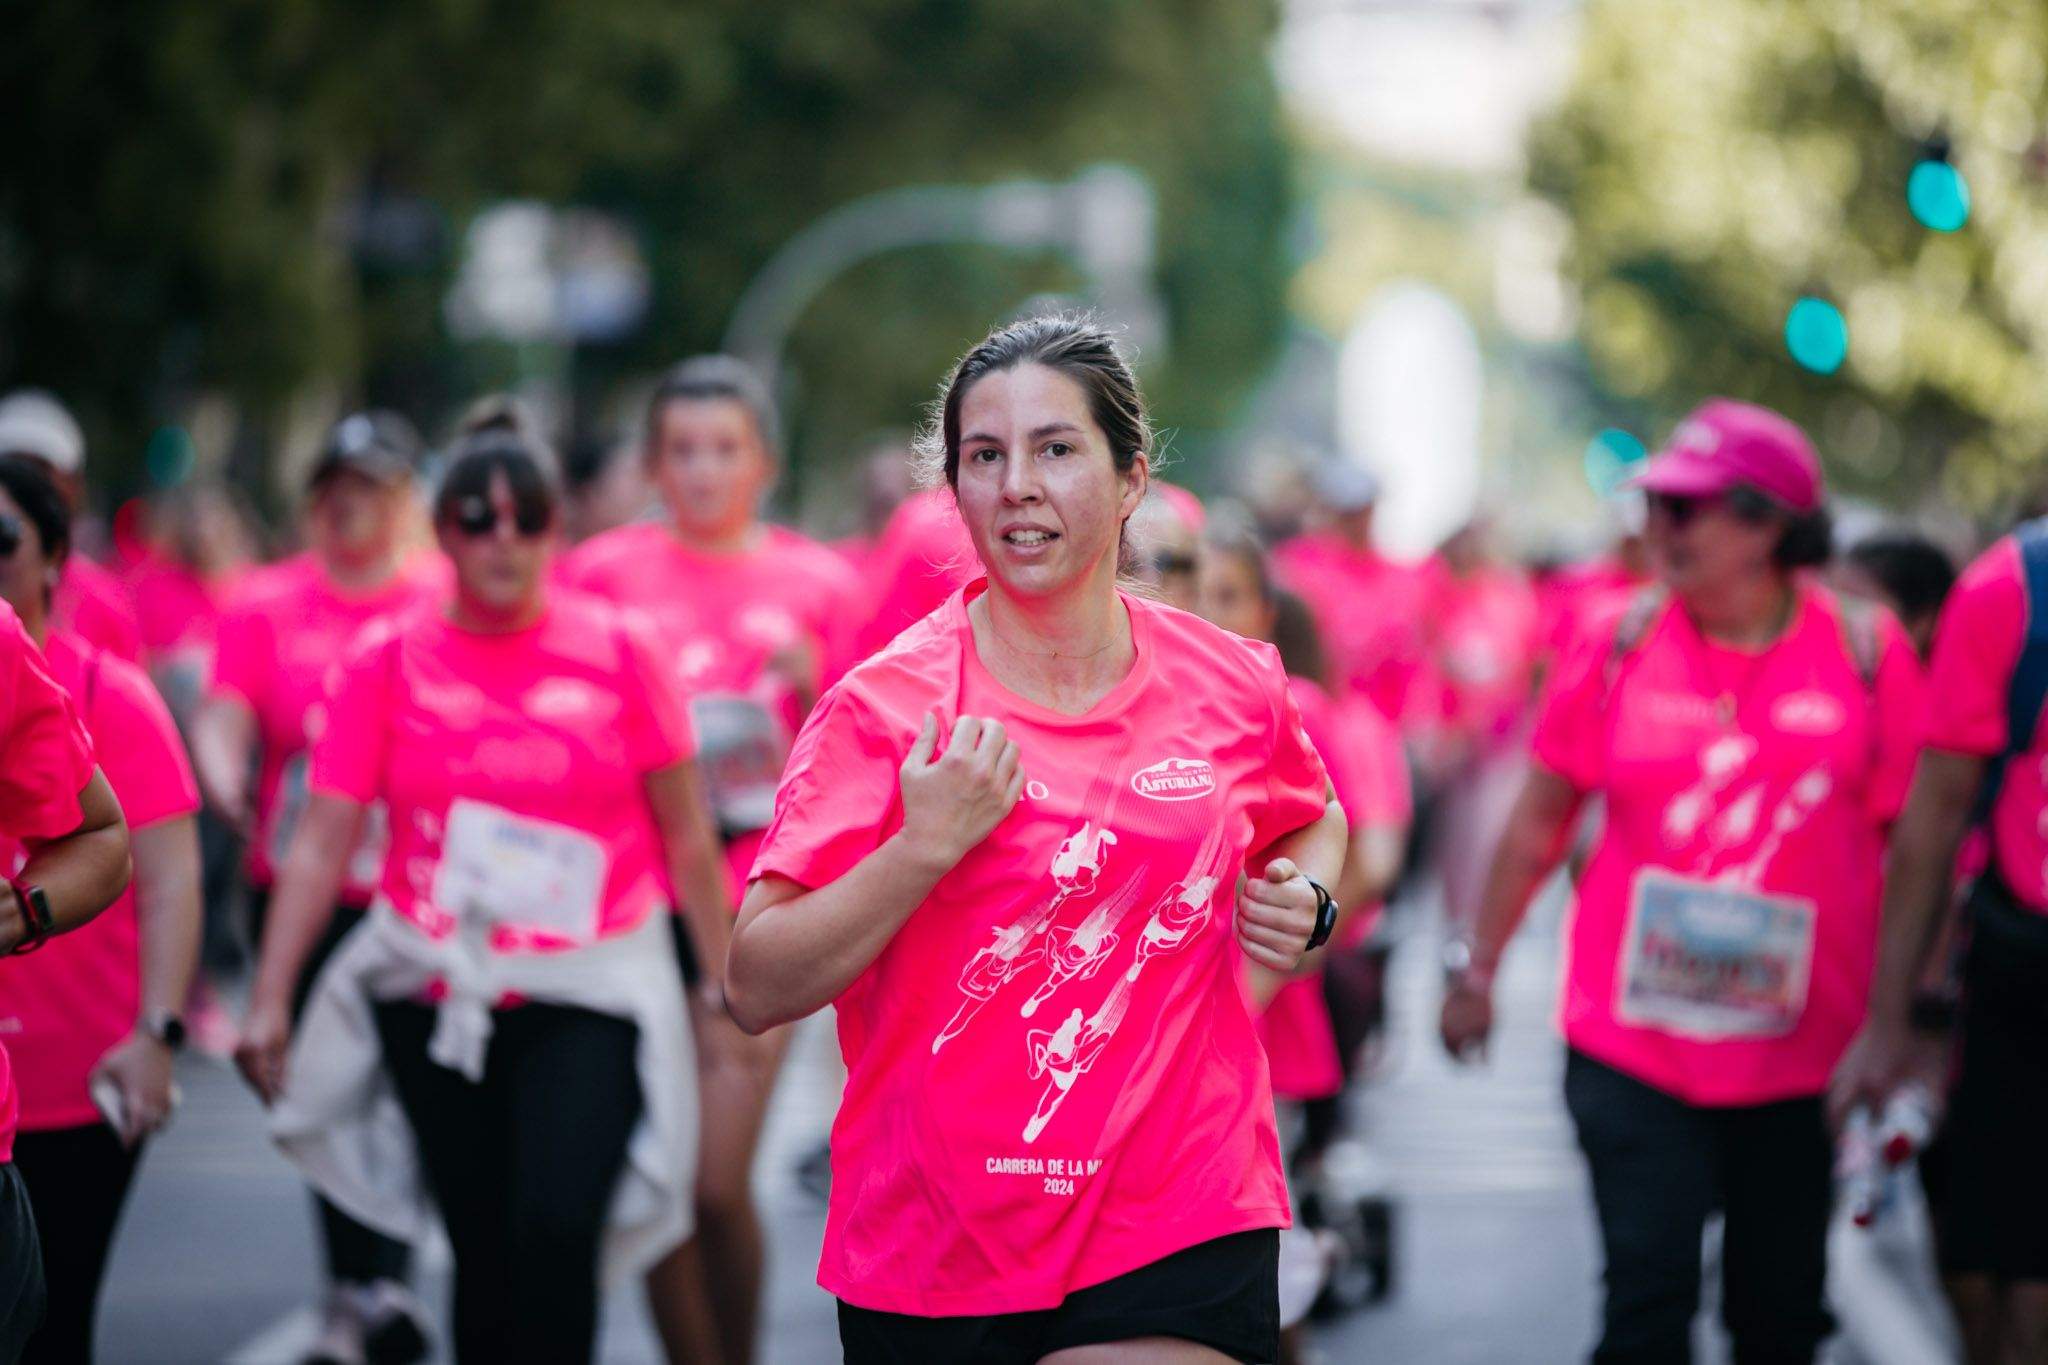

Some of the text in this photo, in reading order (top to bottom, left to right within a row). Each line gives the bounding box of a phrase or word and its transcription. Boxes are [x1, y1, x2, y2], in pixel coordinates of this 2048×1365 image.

[986, 1157, 1044, 1175] CARRERA
[1047, 1159, 1064, 1175] DE
[1068, 1160, 1084, 1176] LA
[1044, 1177, 1074, 1195] 2024
